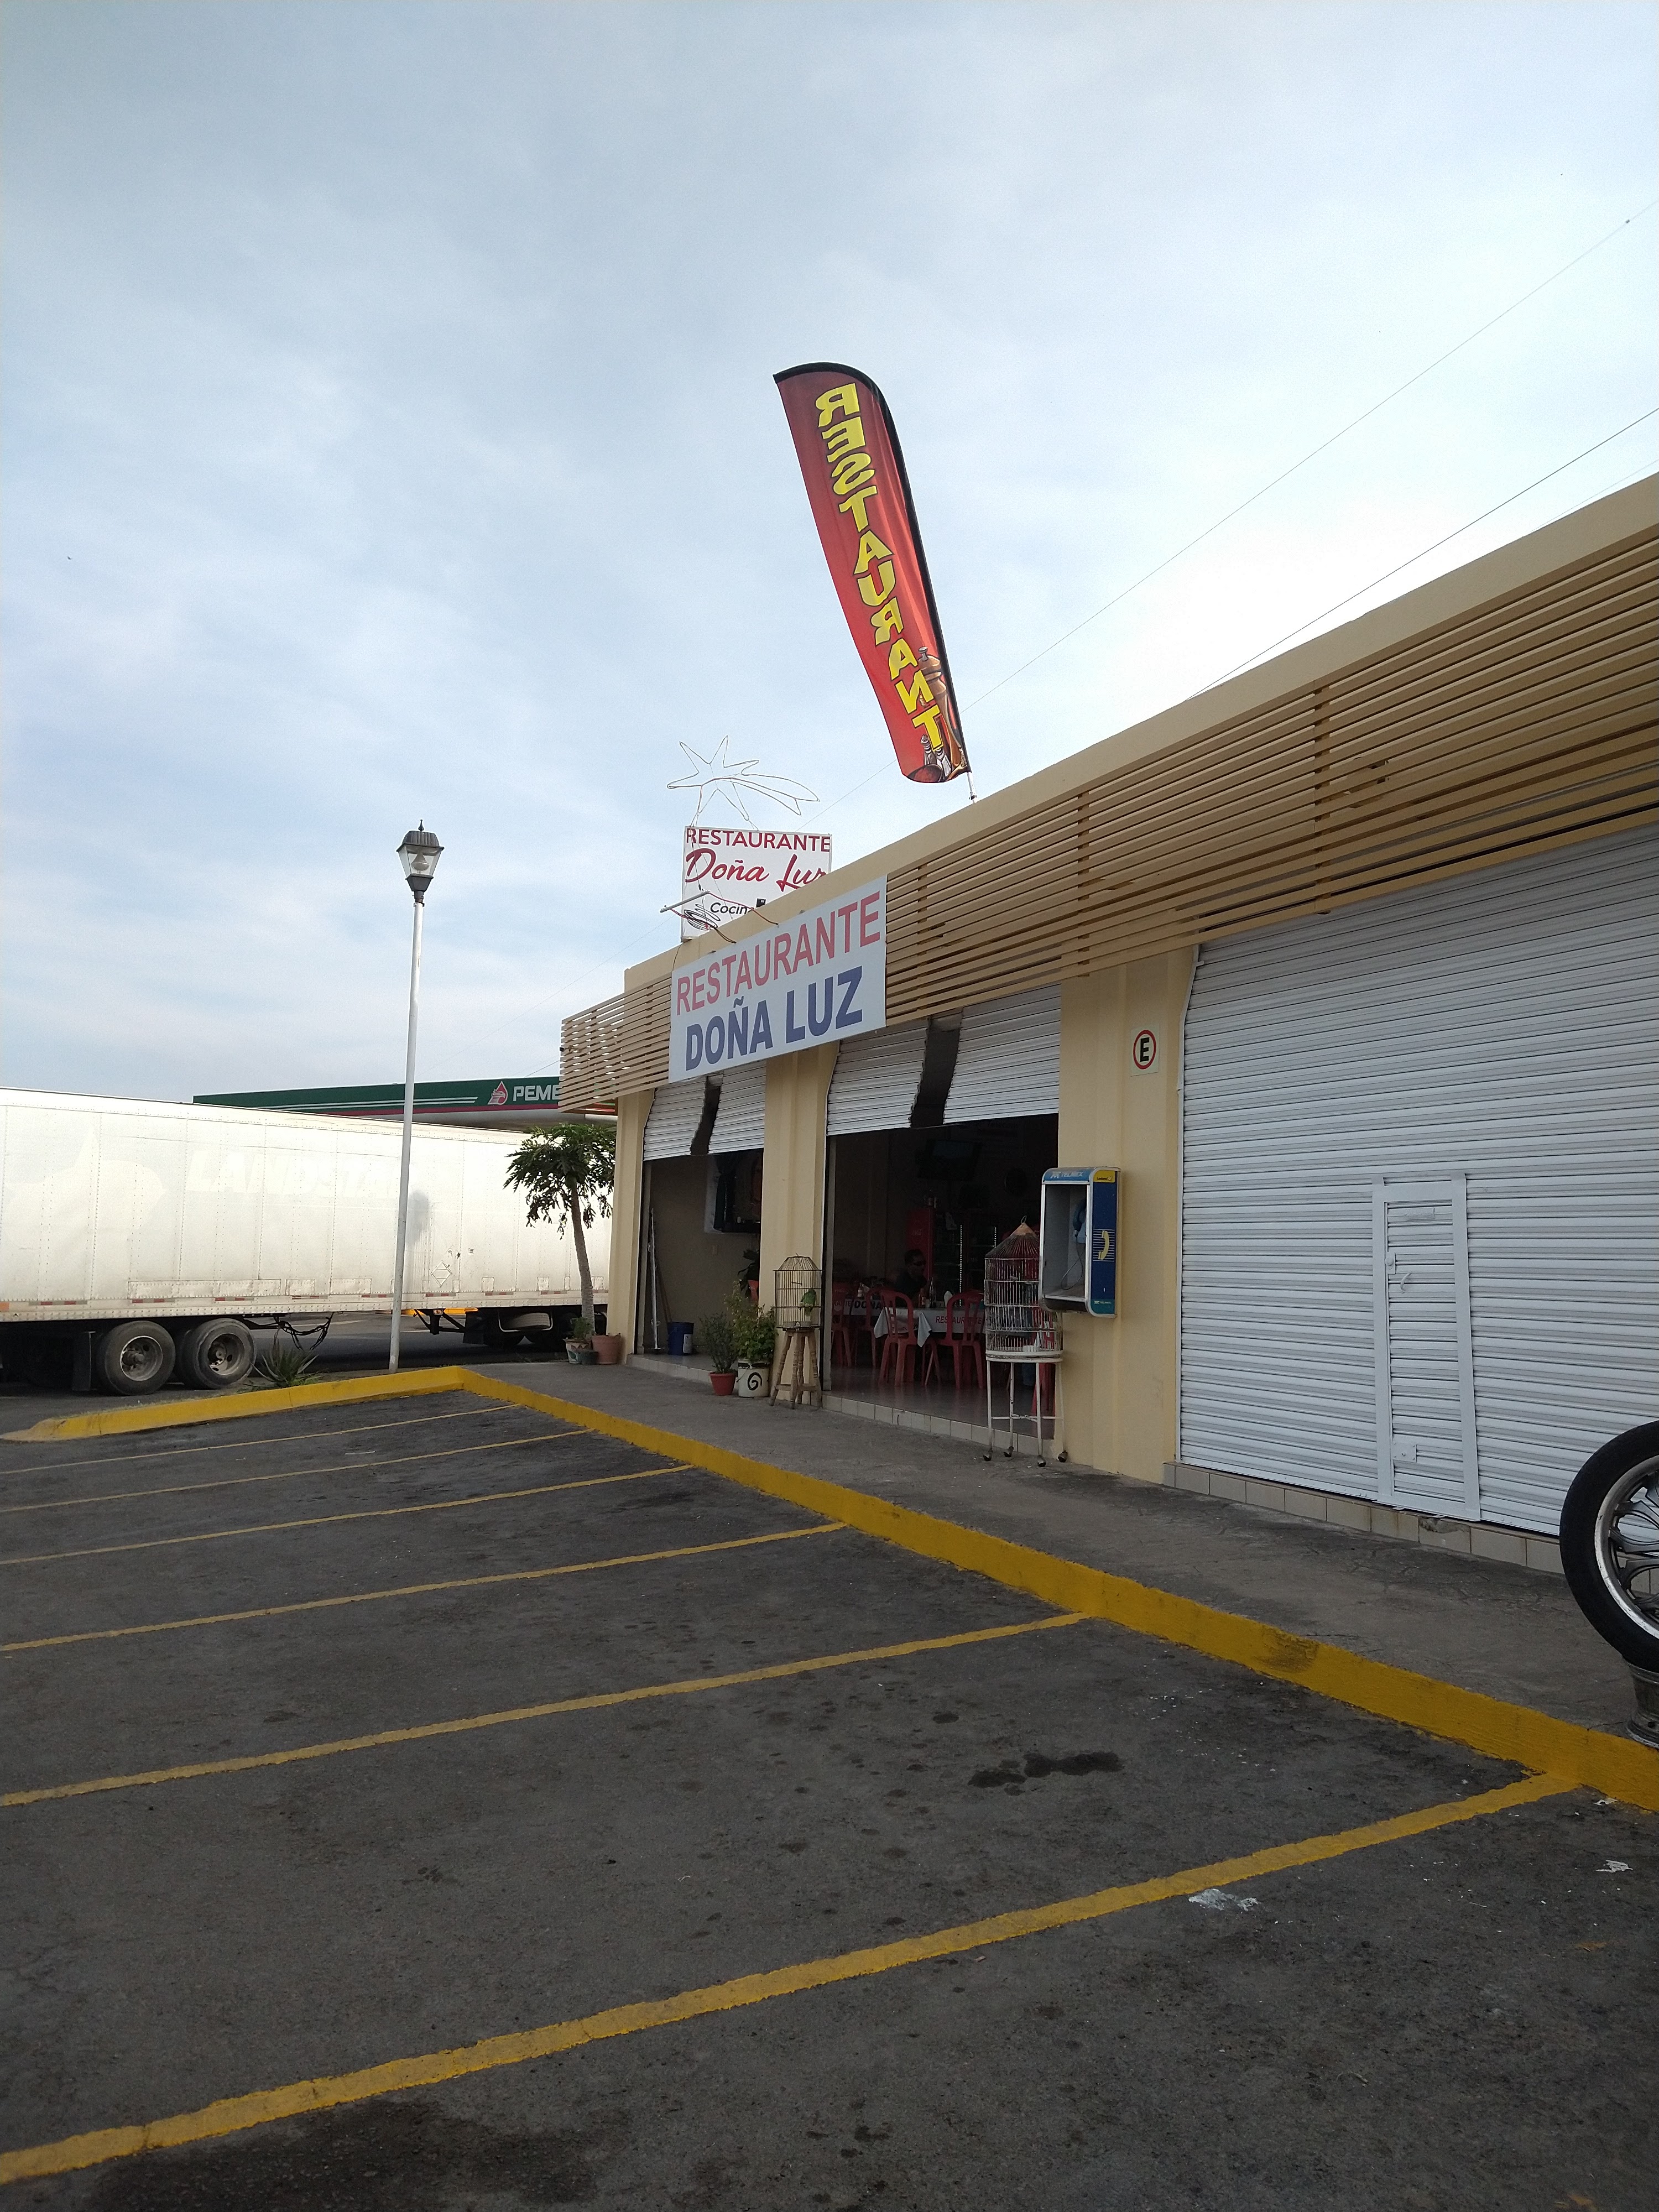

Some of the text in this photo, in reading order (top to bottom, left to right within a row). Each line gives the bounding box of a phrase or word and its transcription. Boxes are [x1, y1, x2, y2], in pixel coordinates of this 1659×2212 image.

[686, 828, 830, 852] RESTAURANTE
[685, 848, 770, 883] Doña
[676, 891, 880, 1016] RESTAURANTE
[685, 966, 863, 1071] DOÑA LUZ
[1140, 1037, 1150, 1062] E
[513, 1084, 560, 1102] PEME
